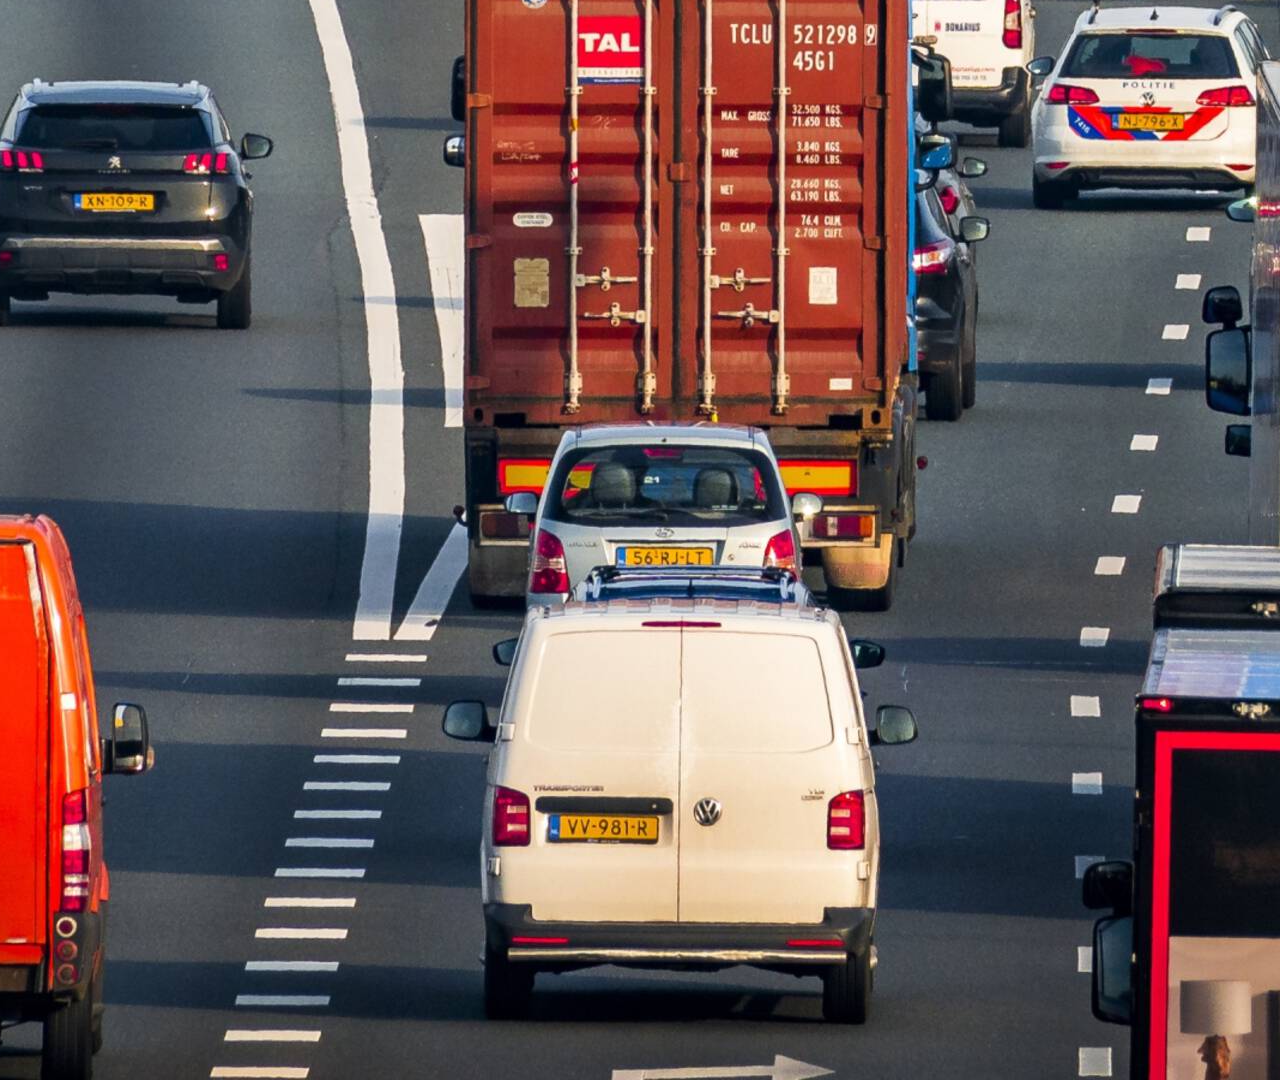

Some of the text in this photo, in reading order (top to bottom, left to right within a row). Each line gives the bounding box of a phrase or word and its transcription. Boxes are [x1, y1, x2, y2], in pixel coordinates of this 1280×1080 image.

[579, 33, 641, 52] TAL
[730, 24, 877, 45] TCLU 521298 9
[793, 51, 834, 70] 45G1
[1122, 81, 1176, 89] POLITIE
[721, 148, 739, 158] TARE
[568, 819, 648, 836] VV-981-R
